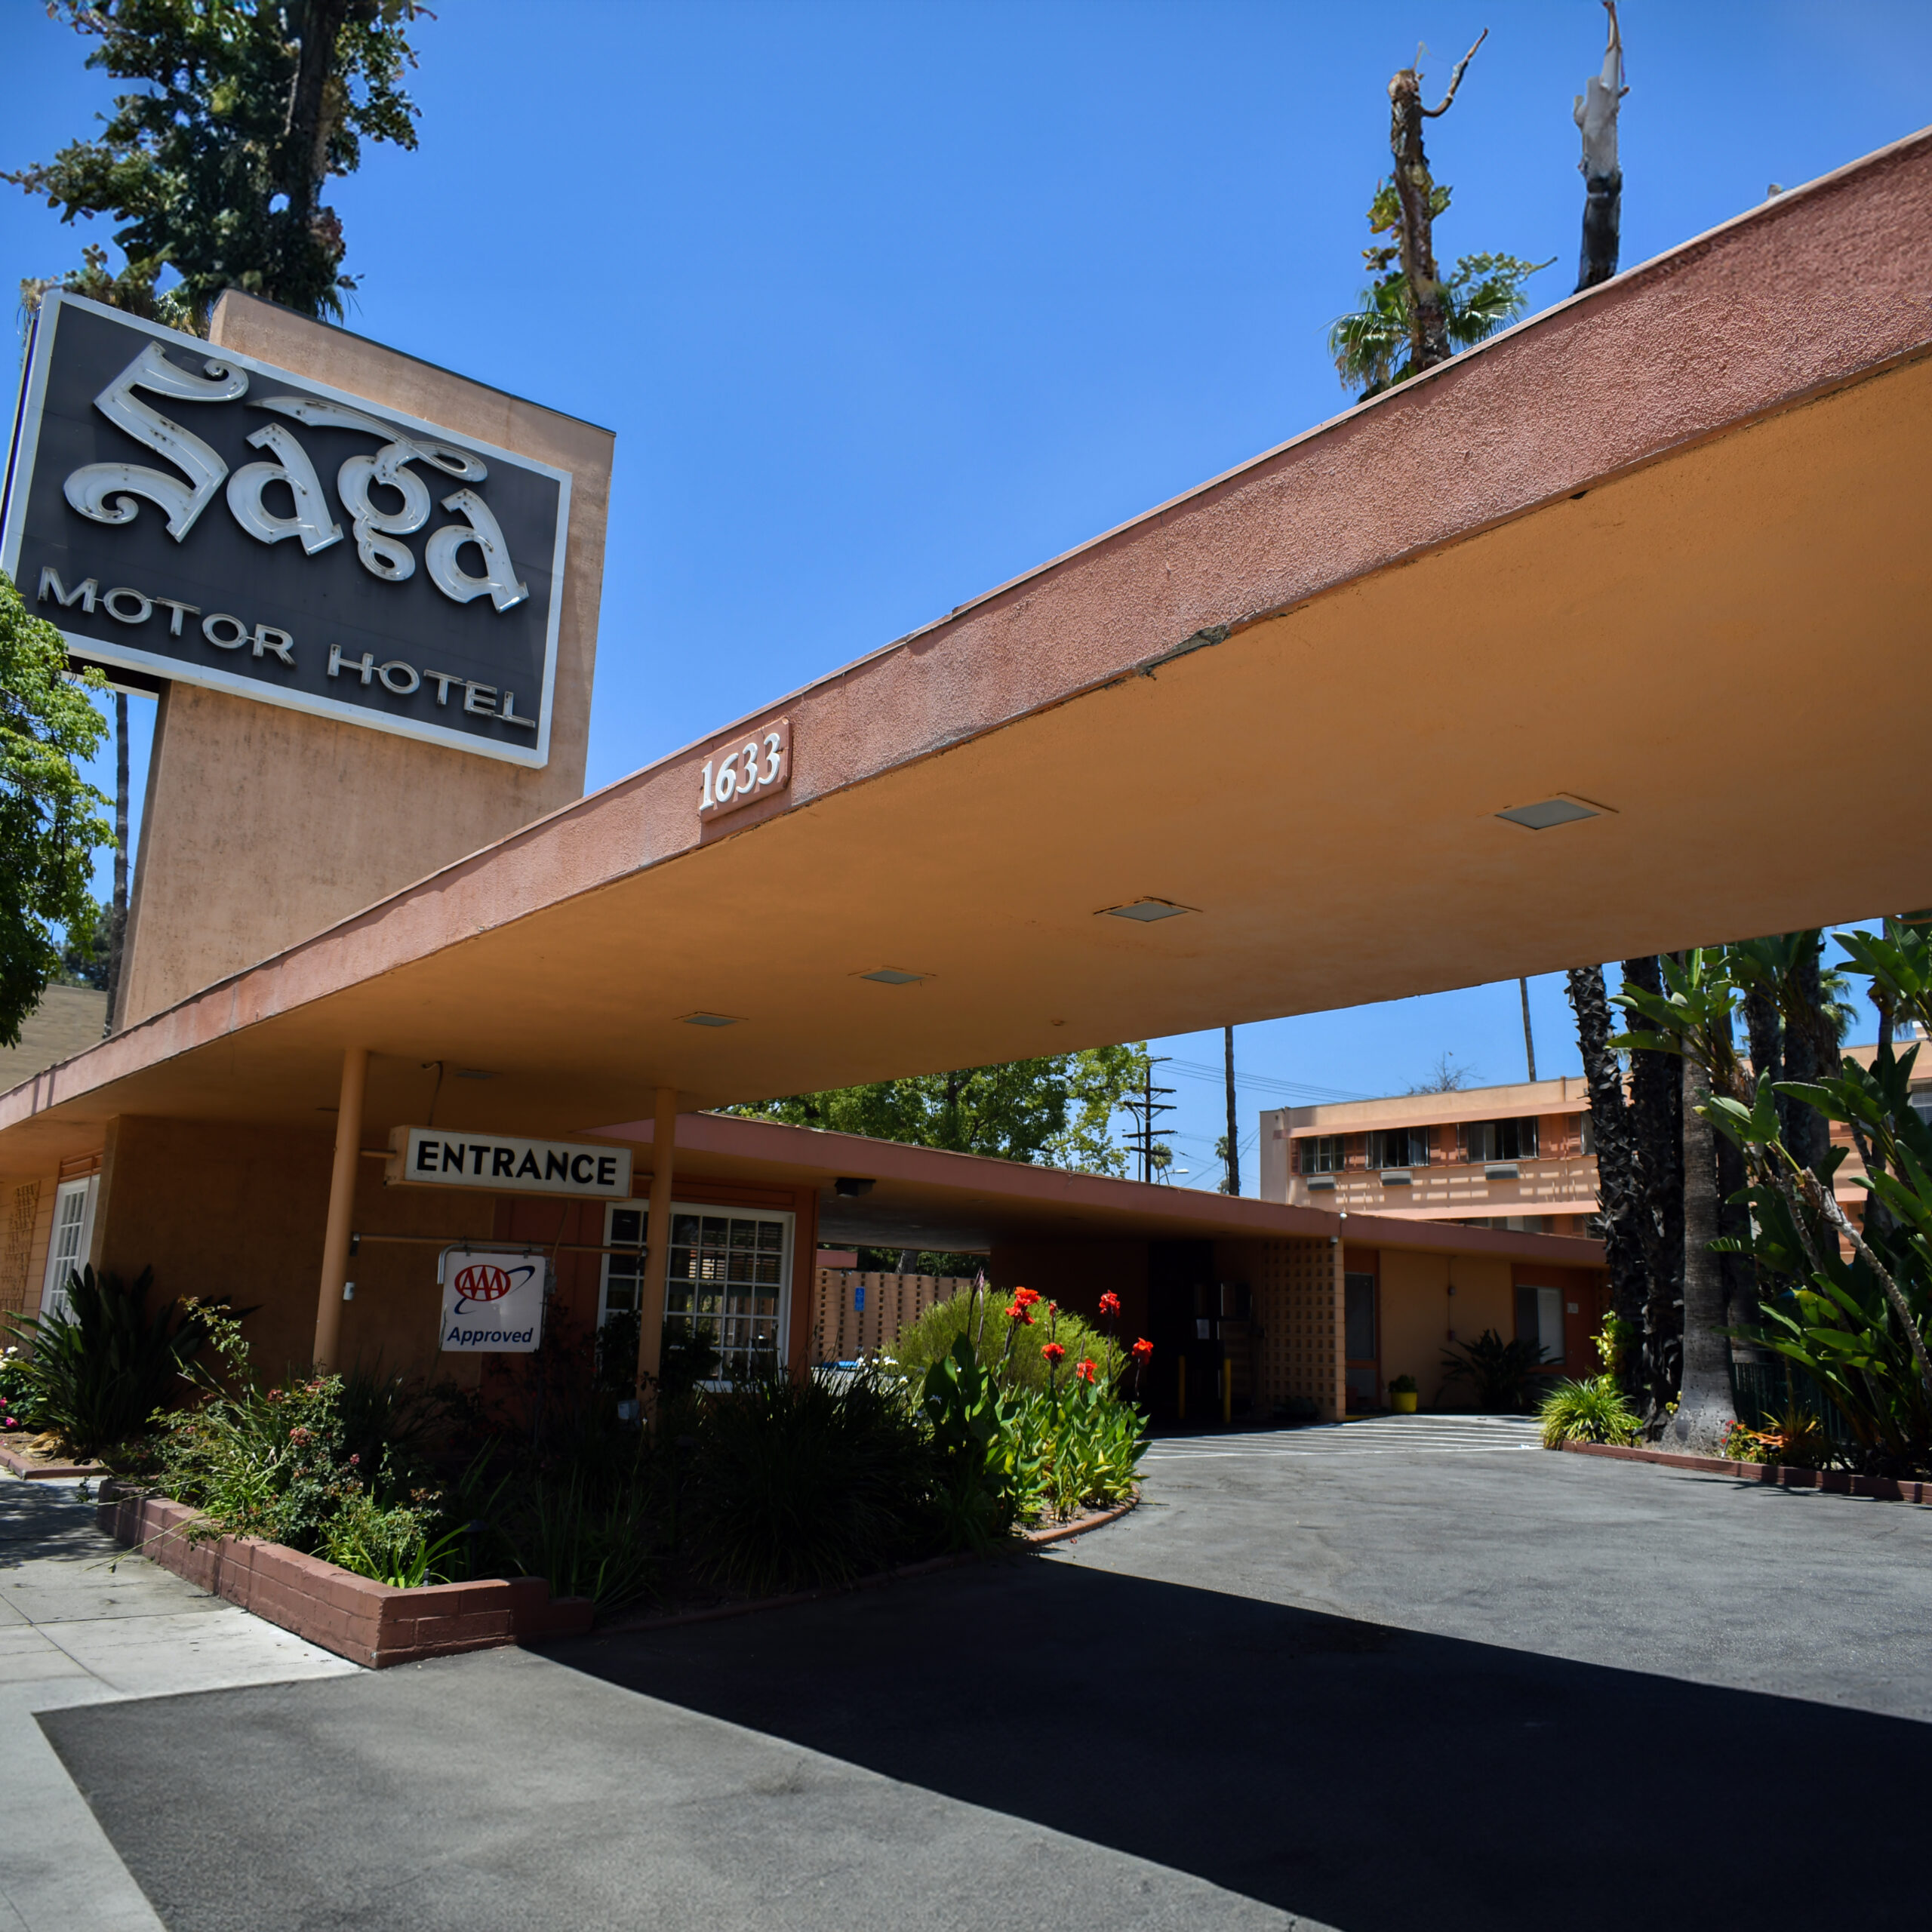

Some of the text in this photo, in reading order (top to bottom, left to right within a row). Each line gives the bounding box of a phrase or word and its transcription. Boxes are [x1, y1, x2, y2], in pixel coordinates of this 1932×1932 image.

[63, 340, 530, 613] Saga
[38, 566, 536, 729] MOTOR HOTEL
[699, 732, 780, 811] 1633
[417, 1140, 617, 1186] ENTRANCE
[459, 1266, 506, 1300] AAA
[447, 1327, 534, 1346] Approved
